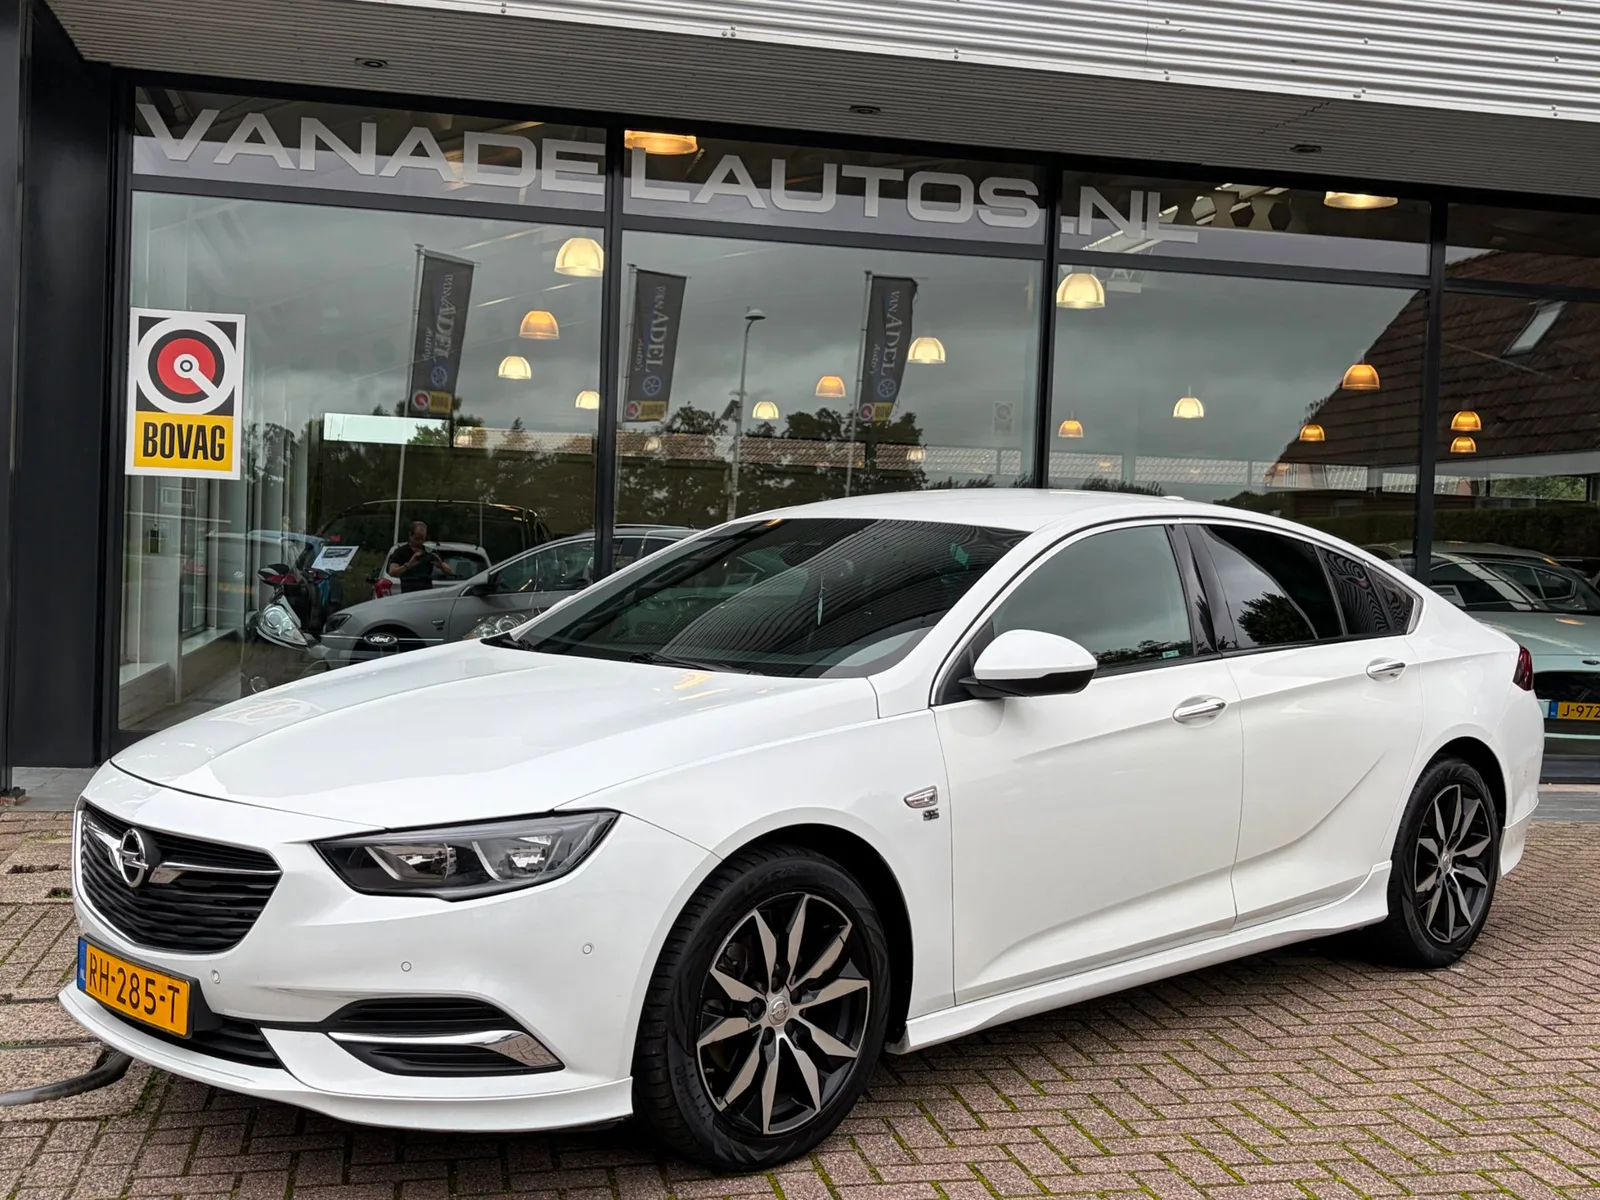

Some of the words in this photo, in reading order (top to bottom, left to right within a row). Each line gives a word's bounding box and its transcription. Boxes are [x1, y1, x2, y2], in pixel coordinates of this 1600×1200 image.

[142, 421, 225, 461] BOVAG
[370, 634, 391, 643] Ford
[89, 952, 180, 1023] RH-285-T
